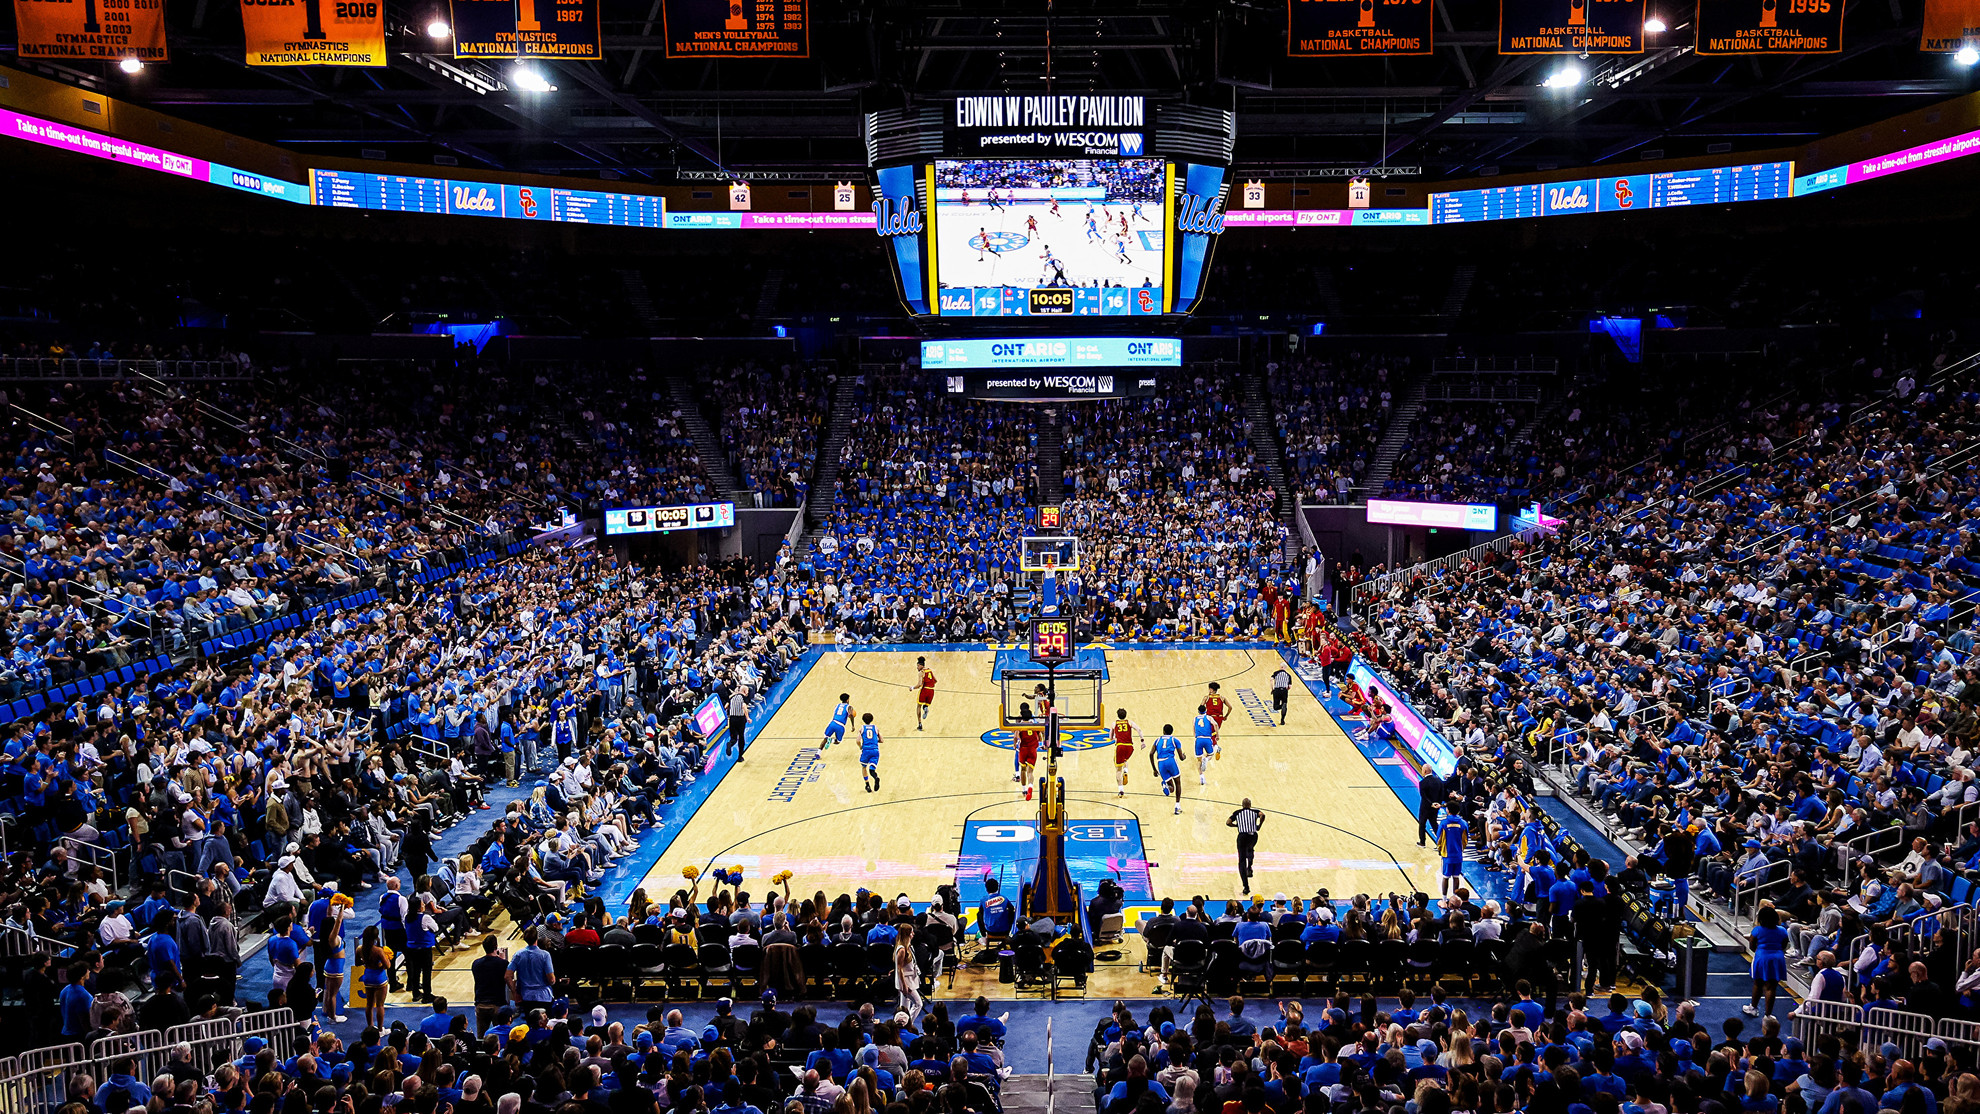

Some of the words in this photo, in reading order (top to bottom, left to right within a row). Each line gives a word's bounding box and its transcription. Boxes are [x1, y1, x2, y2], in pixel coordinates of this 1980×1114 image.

[336, 2, 377, 18] 2018
[755, 4, 775, 12] 1972
[1789, 0, 1831, 14] 1995
[104, 12, 130, 22] 2001
[556, 10, 583, 22] 1987
[105, 24, 132, 34] 2003
[756, 22, 775, 30] 1975
[1539, 26, 1605, 35] BASKETBALL
[495, 32, 557, 42] GYMNASTICS
[694, 31, 722, 39] MEN'S
[723, 31, 779, 40] VOLLEYBALL
[1328, 29, 1394, 38] BASKETBALL
[1735, 28, 1802, 38] BASKETBALL
[56, 33, 128, 45] GYMNASTICS
[1300, 39, 1352, 51] NATIONAL
[1360, 37, 1420, 50] CHAMPIONS
[1511, 36, 1563, 48] NATIONAL
[1572, 35, 1632, 48] CHAMPIONS
[1709, 38, 1763, 50] NATIONAL
[1768, 37, 1828, 49] CHAMPIONS
[22, 43, 85, 56] NATIONAL
[90, 45, 164, 58] CHAMPIONS
[284, 41, 349, 52] GYMNASTICS
[459, 42, 518, 54] NATIONAL
[525, 43, 594, 55] CHAMPIONS
[676, 41, 732, 52] NATIONAL
[734, 41, 799, 52] CHAMPIONS
[260, 52, 311, 63] NATIONAL
[312, 52, 371, 63] CHAMPIONS
[956, 96, 1003, 127] EDWIN
[1005, 96, 1021, 127] W
[1024, 96, 1077, 127] PAULEY
[1079, 96, 1144, 127] PAVILION
[16, 118, 38, 135] Take
[39, 127, 45, 137] a
[46, 126, 81, 146] time-out
[82, 135, 100, 150] from
[101, 141, 132, 158] stressful
[133, 147, 161, 164] airports.
[164, 157, 175, 169] Fly
[176, 159, 191, 172] ONT.
[980, 133, 1035, 147] presented
[1037, 133, 1052, 147] by
[1054, 132, 1118, 147] WESCOM
[1085, 147, 1118, 155] Financial
[1862, 164, 1877, 174] Take
[1876, 163, 1881, 171] a
[1881, 158, 1908, 170] time-out
[1908, 152, 1923, 164] from
[1923, 142, 1952, 159] stressful
[1952, 136, 1980, 152] airports.
[453, 186, 496, 211] Ucla
[734, 193, 746, 203] 42
[839, 193, 851, 203] 25
[1248, 191, 1261, 201] 33
[1355, 191, 1364, 200] 11
[1550, 185, 1589, 210] Ucla
[673, 215, 712, 223] ONTARIO
[752, 215, 775, 224] Take
[784, 215, 823, 224] time-out
[825, 215, 848, 224] from
[849, 216, 877, 224] stress
[872, 195, 923, 236] Ucla
[1178, 193, 1225, 235] Ucla
[1225, 212, 1255, 221] ressful
[1256, 212, 1294, 223] airports.
[1300, 214, 1314, 224] Fly
[1316, 213, 1338, 222] ONT.
[1362, 212, 1401, 220] ONTARIO
[1017, 290, 1025, 300] 3
[1032, 293, 1072, 305] 10:05
[1077, 290, 1085, 299] 2
[941, 295, 971, 310] Ucla
[979, 297, 996, 309] 15
[1107, 296, 1124, 308] 16
[1014, 307, 1023, 316] 4
[1080, 306, 1088, 316] 4
[991, 342, 1067, 356] ONTARIO
[1127, 342, 1173, 355] ONTARIO
[986, 378, 1027, 390] presented
[1029, 378, 1041, 389] by
[1043, 376, 1096, 388] WESCOM
[631, 512, 643, 522] 15
[656, 509, 687, 521] 10:05
[698, 507, 710, 518] 16
[1041, 514, 1058, 527] 29
[1038, 622, 1067, 634] 10:05
[1038, 635, 1064, 656] 29
[1212, 698, 1218, 706] 5
[1117, 723, 1128, 732] 33
[1197, 718, 1205, 728] 4
[866, 729, 873, 739] 0
[1162, 739, 1167, 749] 1
